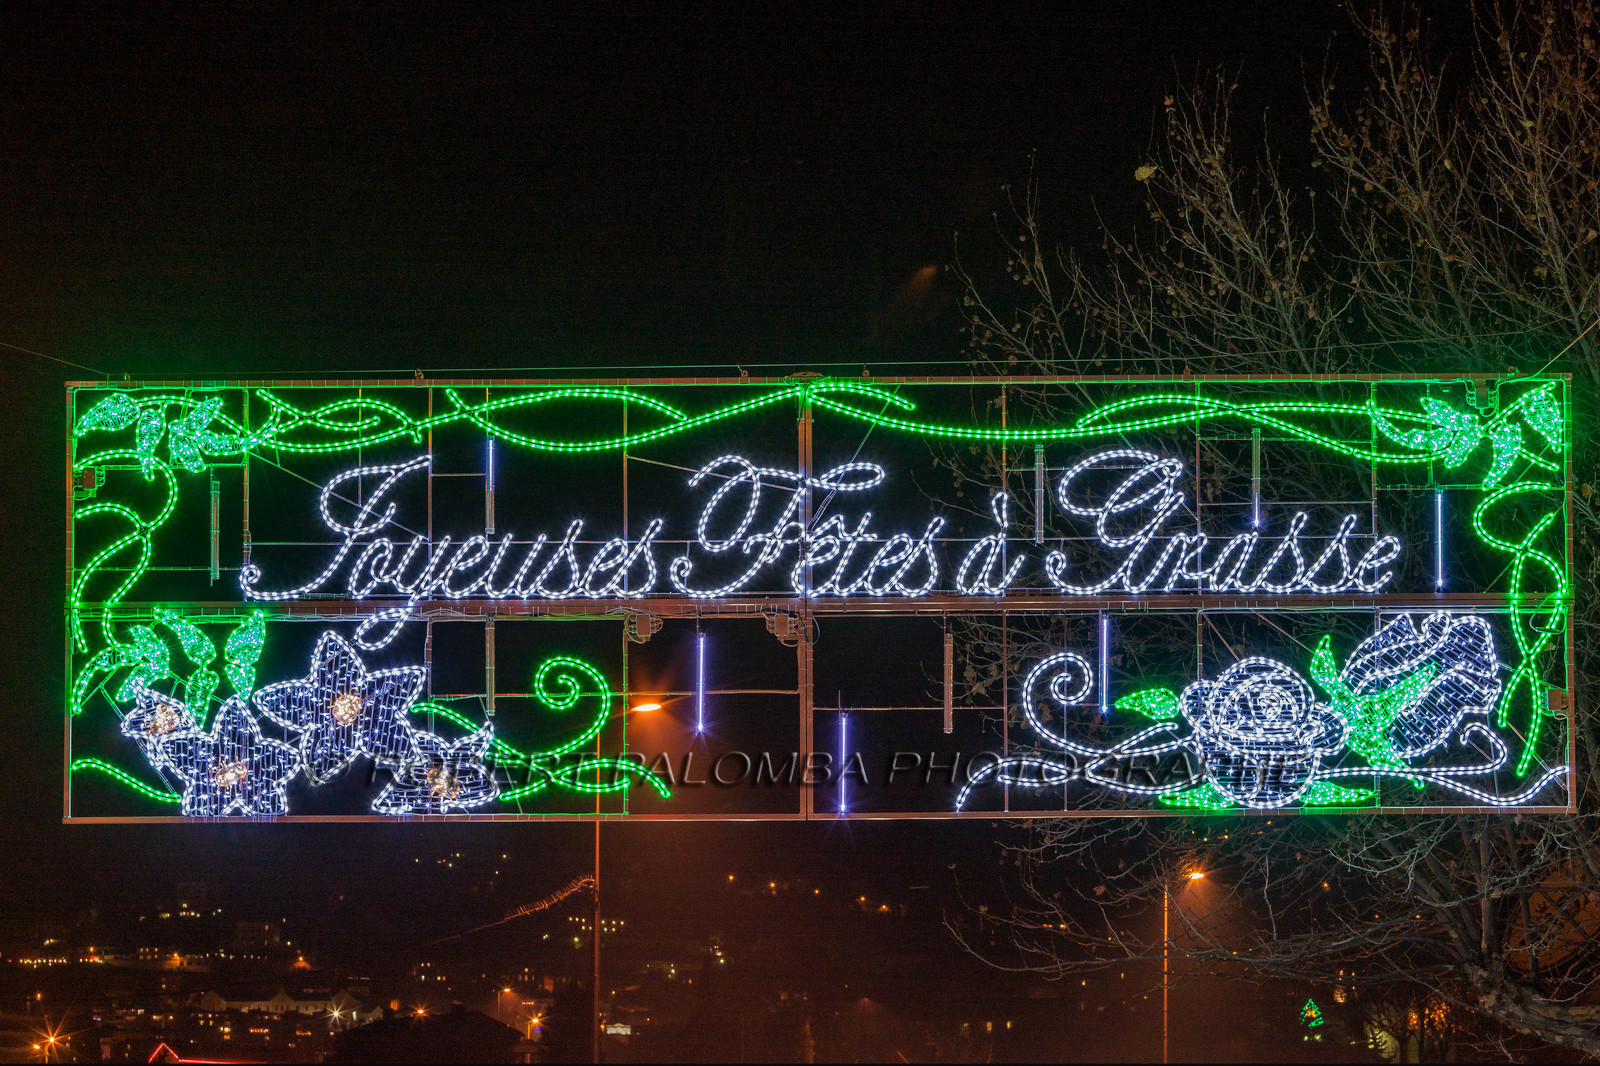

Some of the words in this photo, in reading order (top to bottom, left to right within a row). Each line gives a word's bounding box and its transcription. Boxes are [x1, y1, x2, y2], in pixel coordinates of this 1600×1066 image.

[239, 454, 663, 651] Joyeuses
[669, 454, 947, 598] Fêtes
[1044, 448, 1401, 595] Grasse
